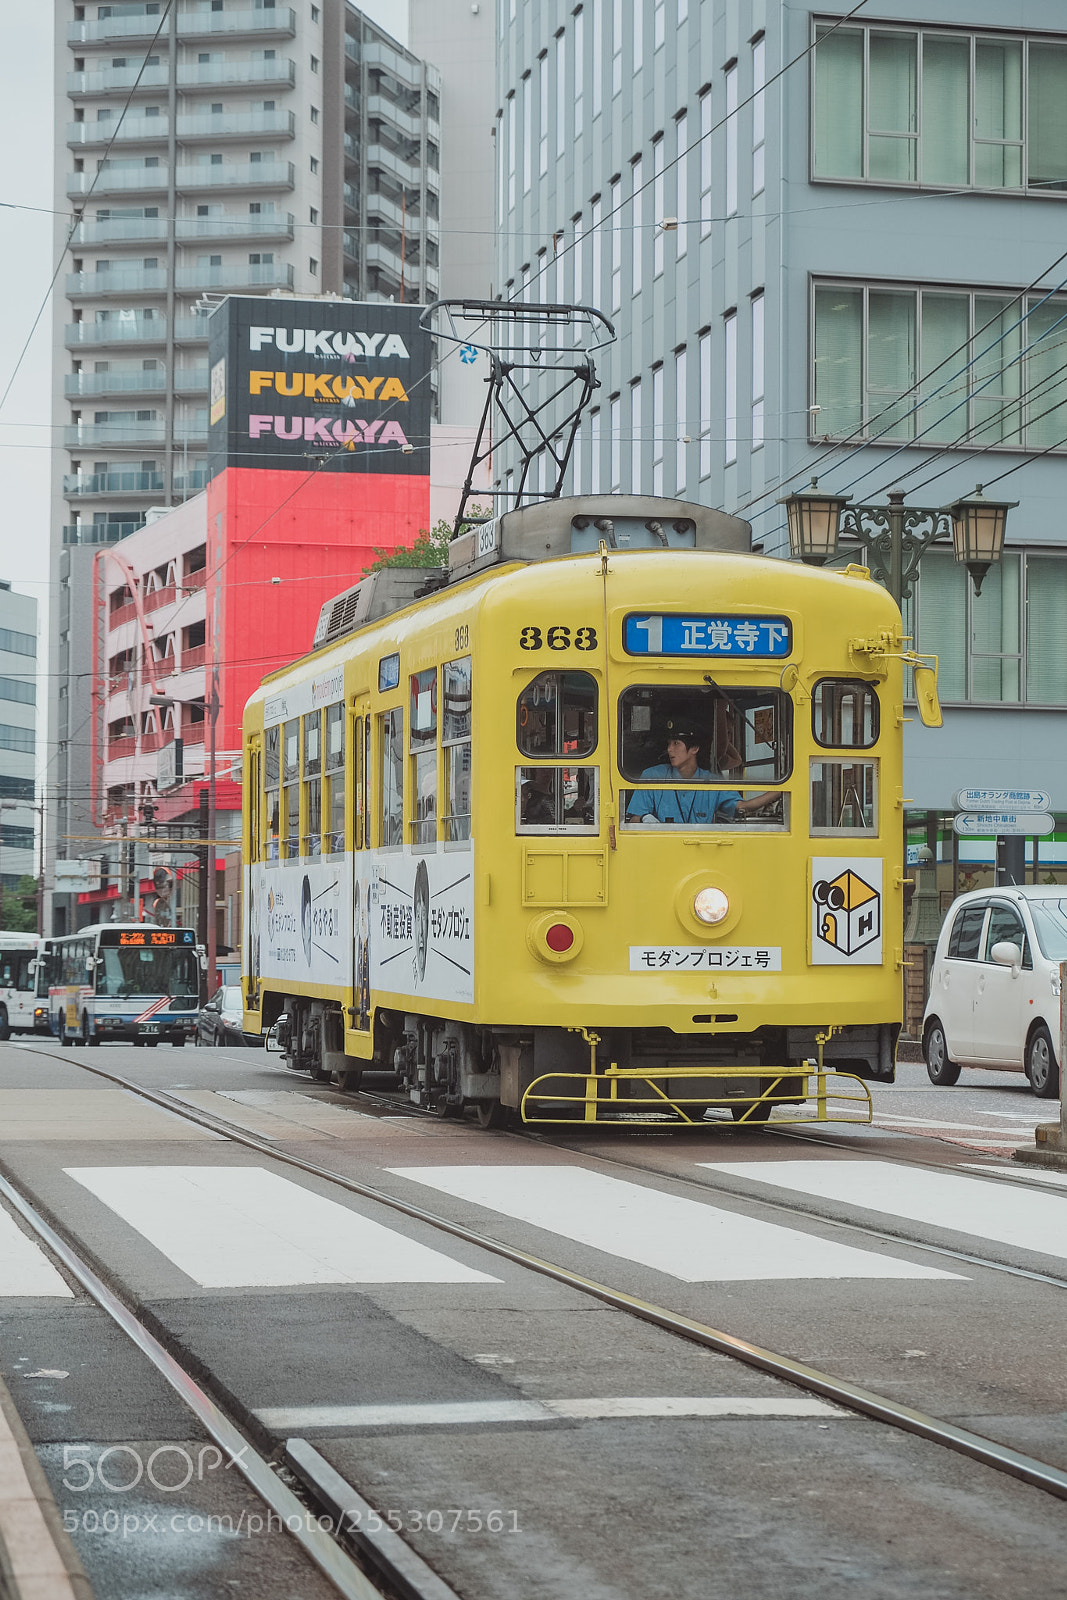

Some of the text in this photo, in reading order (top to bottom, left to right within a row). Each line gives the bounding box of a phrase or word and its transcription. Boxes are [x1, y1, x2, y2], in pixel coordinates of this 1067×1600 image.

[250, 326, 410, 358] FUKUYA
[250, 370, 409, 402] FUKUYA
[249, 414, 408, 445] FUKUYA
[479, 524, 494, 552] 363
[454, 625, 469, 652] 363
[519, 626, 598, 651] 363
[636, 616, 787, 653] 1 正覚寺下
[977, 815, 1017, 823] 新地中華街
[380, 904, 470, 940] 不動産投資 モダンプロジェ
[641, 948, 771, 968] モダンプロジェ号
